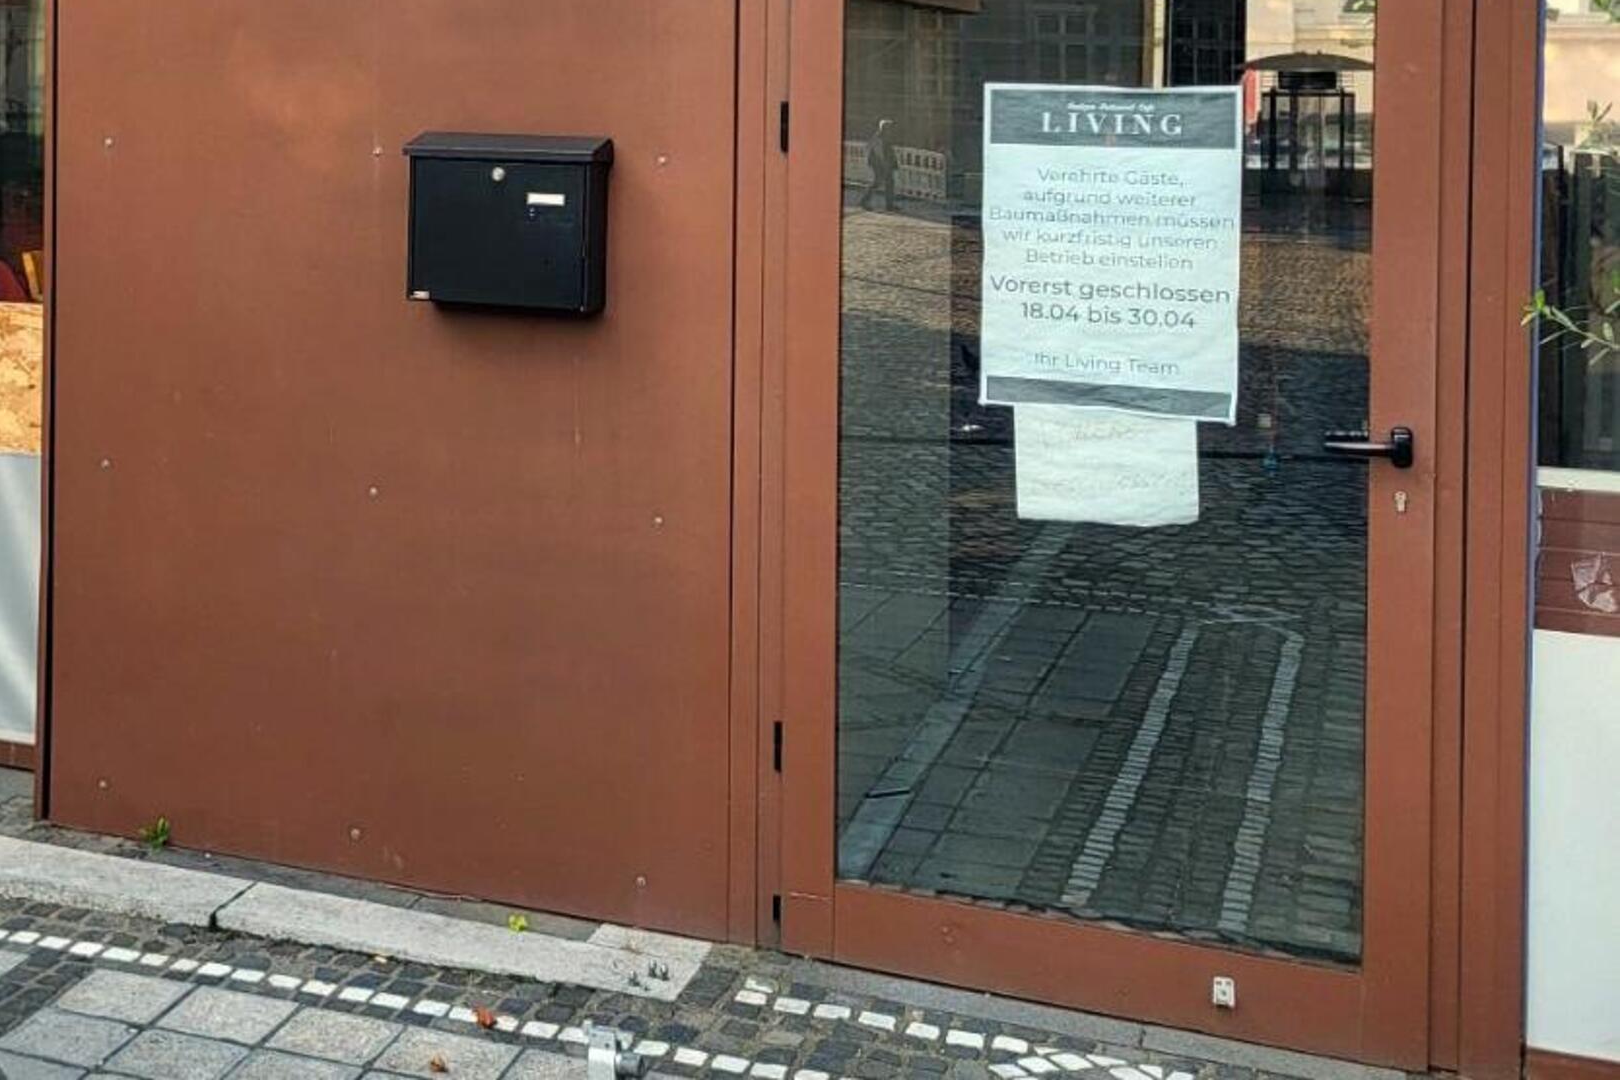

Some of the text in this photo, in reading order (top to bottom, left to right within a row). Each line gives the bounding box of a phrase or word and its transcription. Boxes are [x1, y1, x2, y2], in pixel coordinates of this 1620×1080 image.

[1041, 111, 1183, 136] LIVING
[990, 275, 1231, 304] Vorerst geschlossen
[1021, 302, 1197, 330] 18.04 bis 30.04
[1064, 354, 1121, 372] Living
